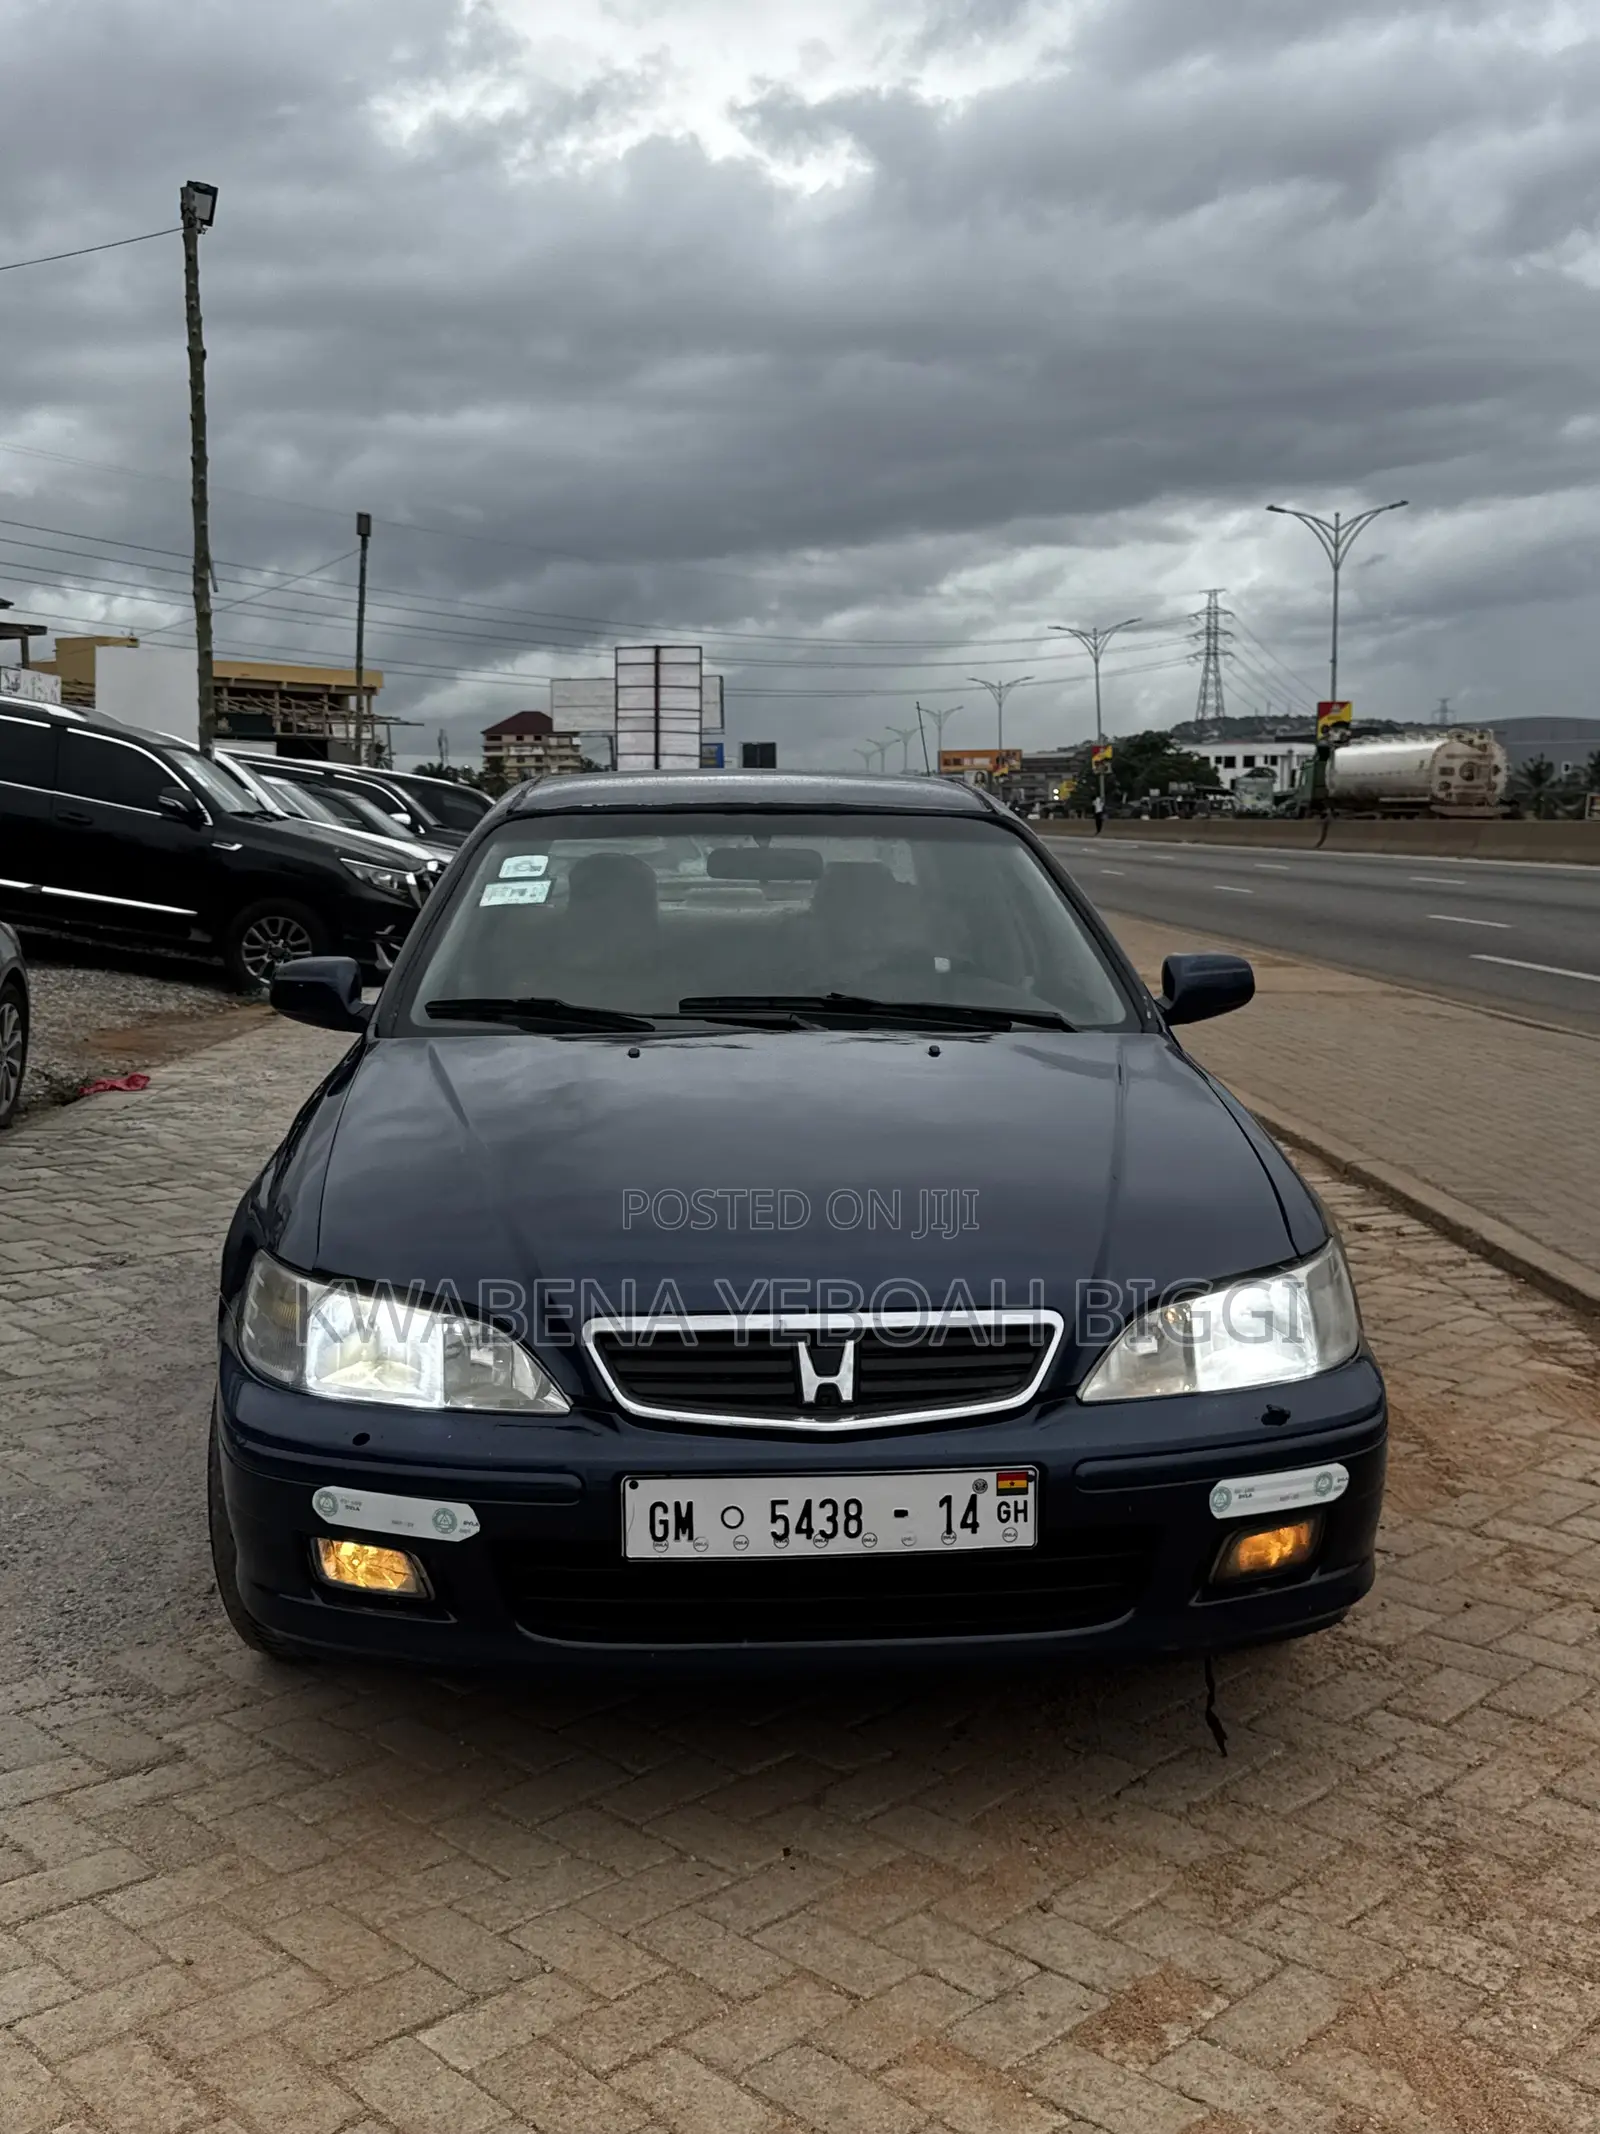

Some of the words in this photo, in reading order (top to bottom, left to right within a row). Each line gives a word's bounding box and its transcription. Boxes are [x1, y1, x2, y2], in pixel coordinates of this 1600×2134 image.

[649, 1501, 694, 1542] GM
[770, 1499, 863, 1540] 5438
[939, 1494, 980, 1535] 14
[997, 1500, 1028, 1524] GH
